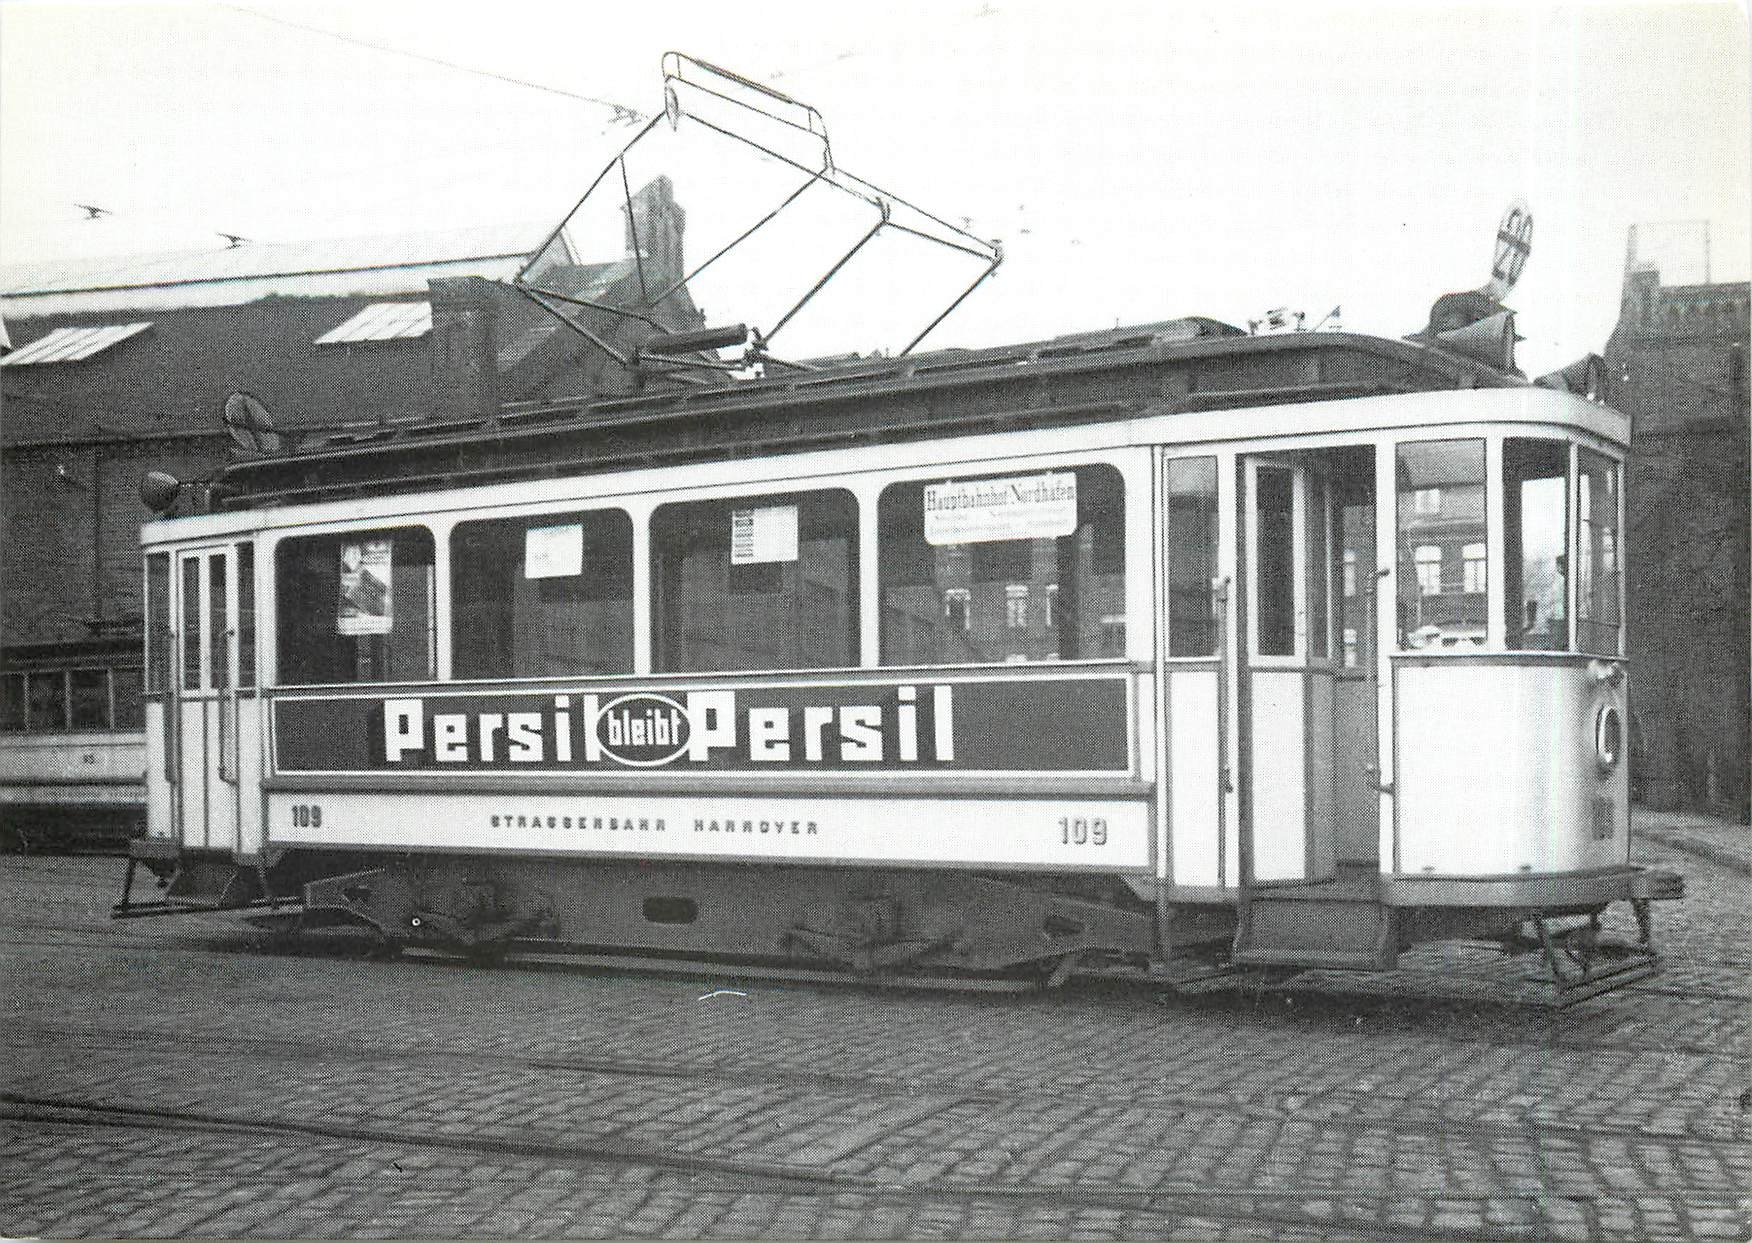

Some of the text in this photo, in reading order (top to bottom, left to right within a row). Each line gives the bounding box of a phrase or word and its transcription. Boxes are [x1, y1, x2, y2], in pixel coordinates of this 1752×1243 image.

[926, 485, 1008, 512] Hauptbahnhof
[384, 685, 954, 762] Persil bleibt Persil
[291, 804, 322, 829] 109
[490, 815, 818, 836] STRASSENBAHN HANNOVER
[1058, 817, 1107, 846] 109
